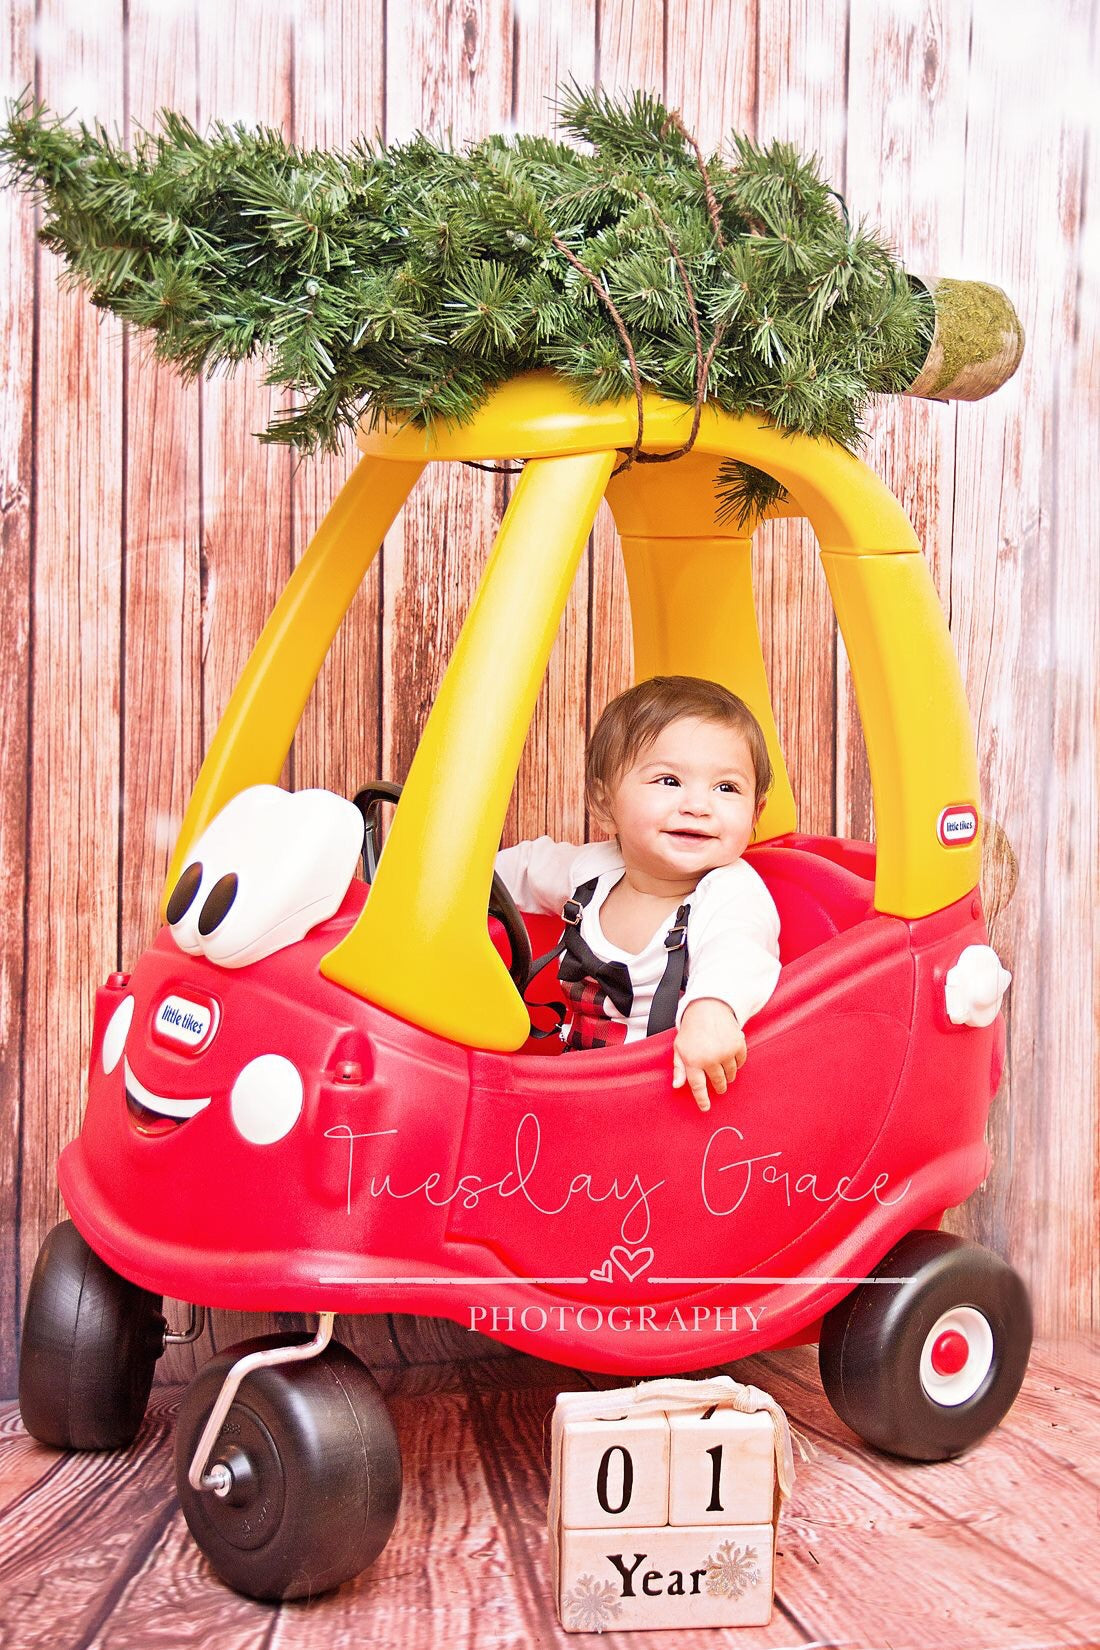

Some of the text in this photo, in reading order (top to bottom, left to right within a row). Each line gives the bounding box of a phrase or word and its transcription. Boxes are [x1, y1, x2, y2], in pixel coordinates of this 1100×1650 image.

[161, 1004, 204, 1034] little tikes
[606, 1553, 707, 1598] Year
